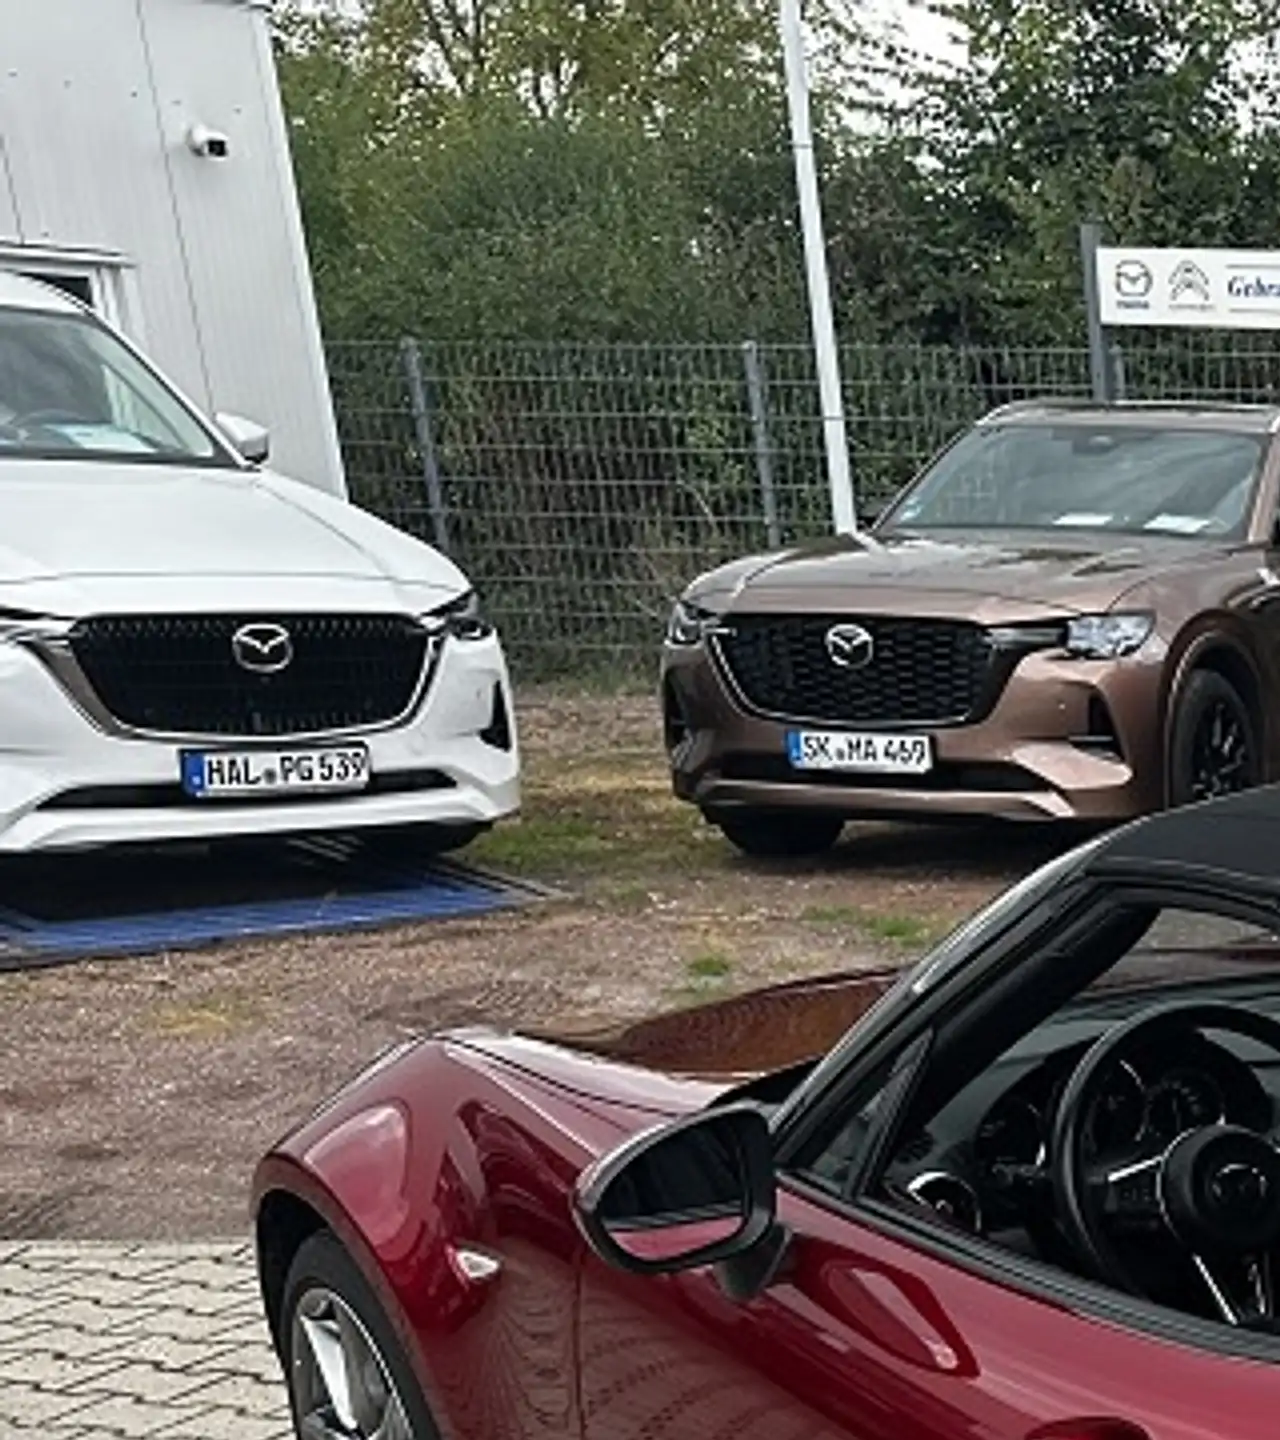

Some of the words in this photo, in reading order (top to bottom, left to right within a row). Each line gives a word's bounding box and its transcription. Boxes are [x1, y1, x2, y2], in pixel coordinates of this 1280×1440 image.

[803, 736, 832, 762] SK
[846, 737, 877, 763] MA
[207, 757, 261, 786] HAL
[280, 755, 314, 782] PG
[319, 752, 366, 782] 539
